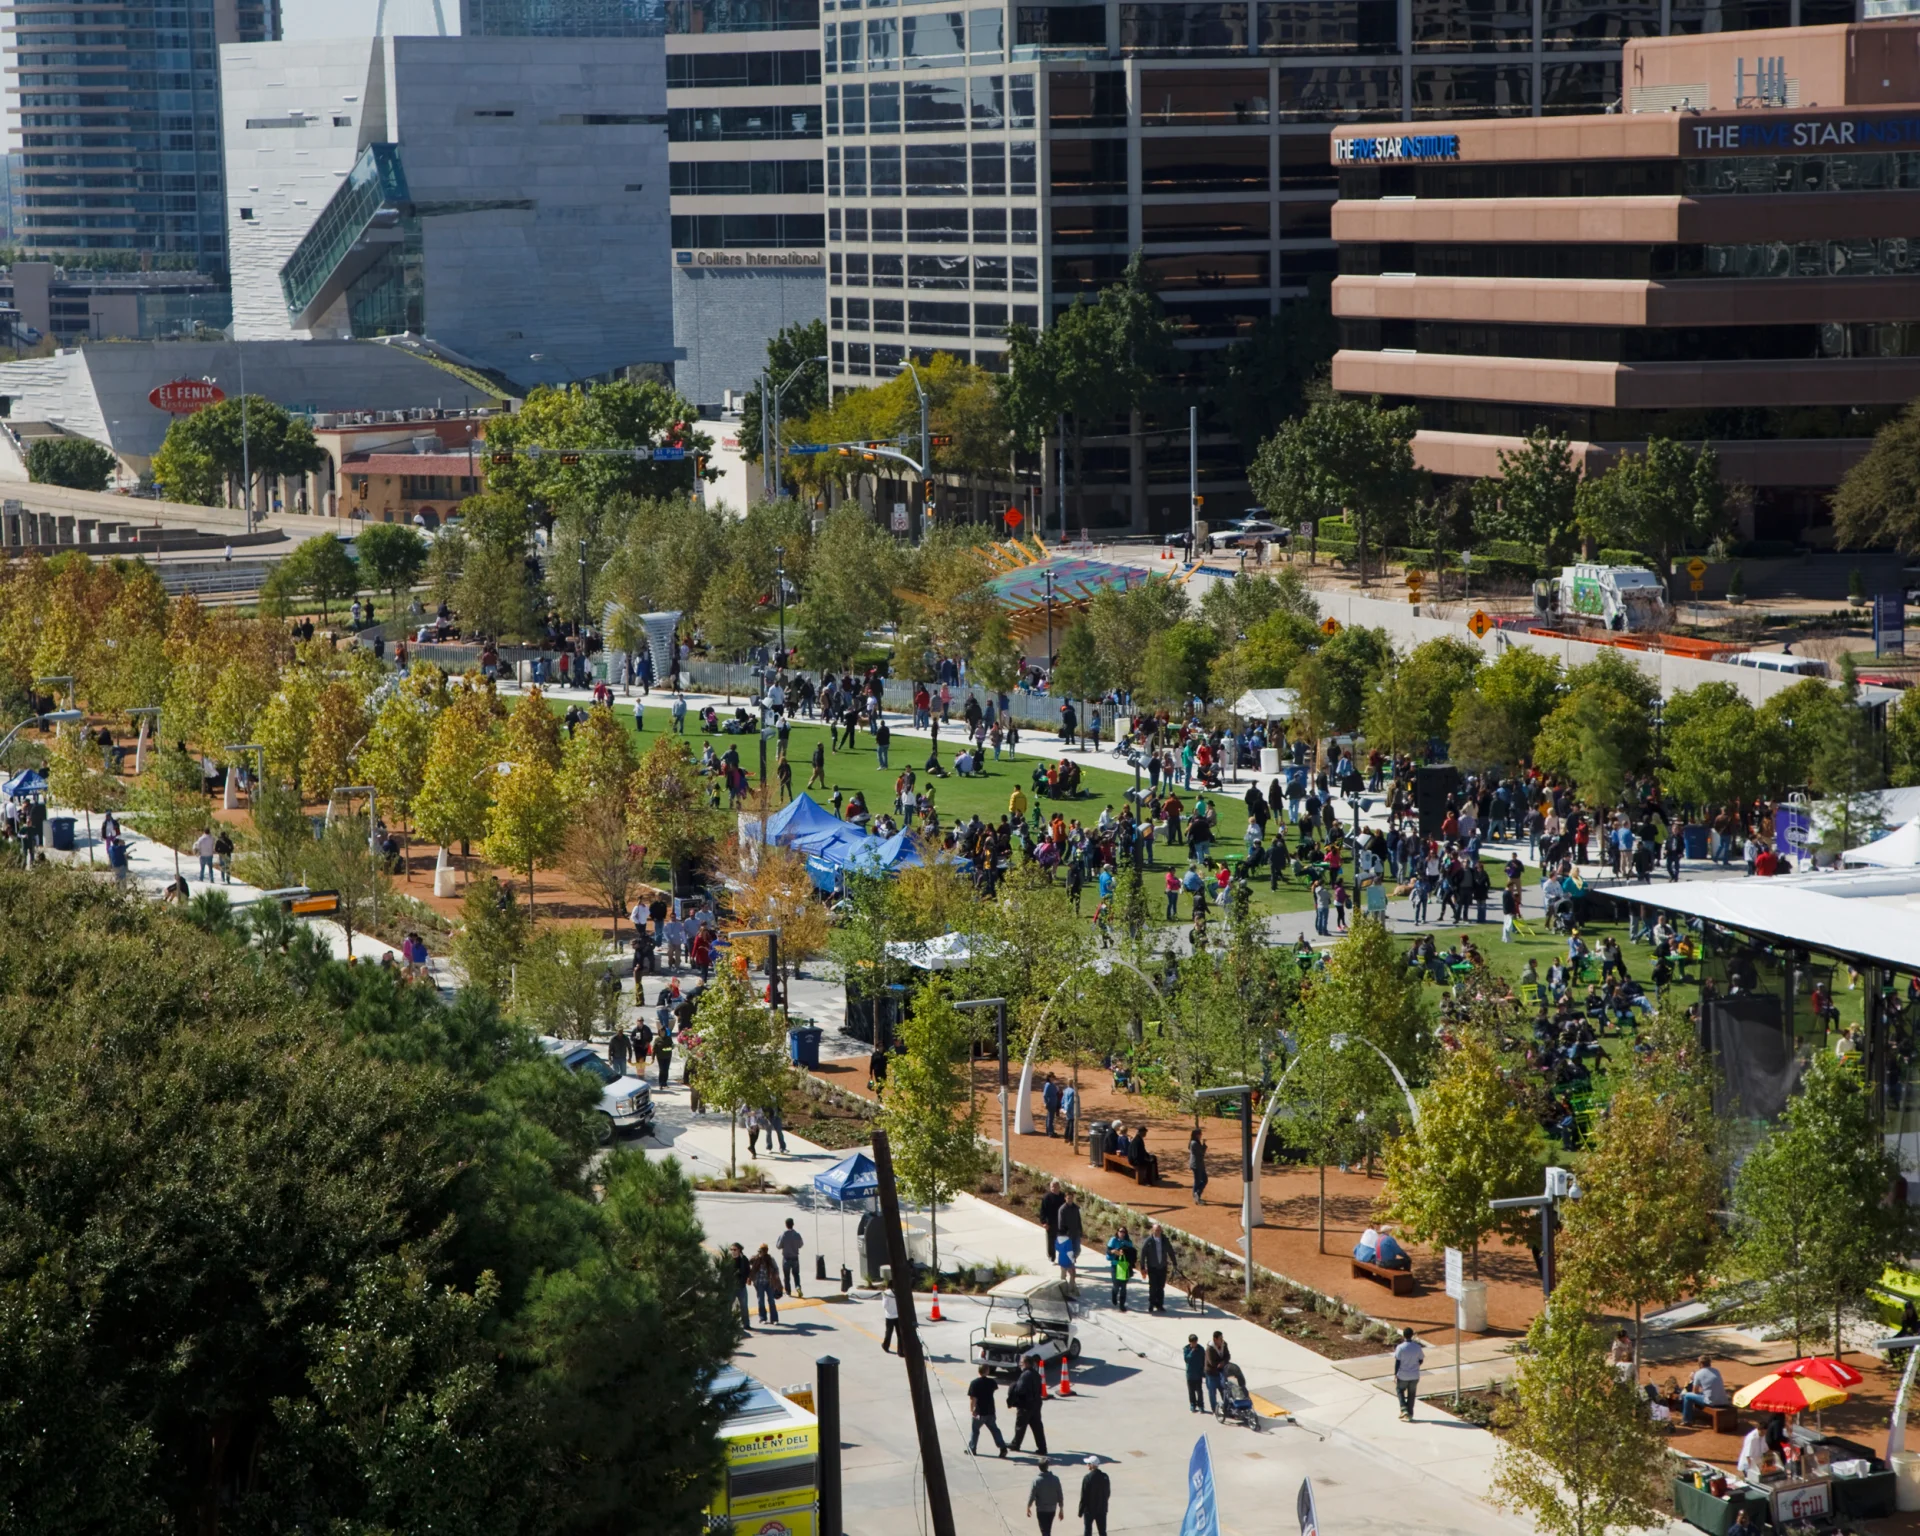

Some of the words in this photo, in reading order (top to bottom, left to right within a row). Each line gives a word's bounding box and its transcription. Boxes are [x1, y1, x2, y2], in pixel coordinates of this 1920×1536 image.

[1693, 125, 1739, 149] THE
[1793, 121, 1855, 146] STAR
[697, 251, 742, 265] Colliers
[746, 251, 821, 265] International
[160, 388, 172, 399] EL
[177, 387, 213, 399] FENIX
[160, 400, 216, 408] Restaura
[731, 1441, 768, 1454] MOBILE
[770, 1439, 784, 1448] NY
[786, 1434, 809, 1445] DELI
[1792, 1495, 1824, 1518] Grill
